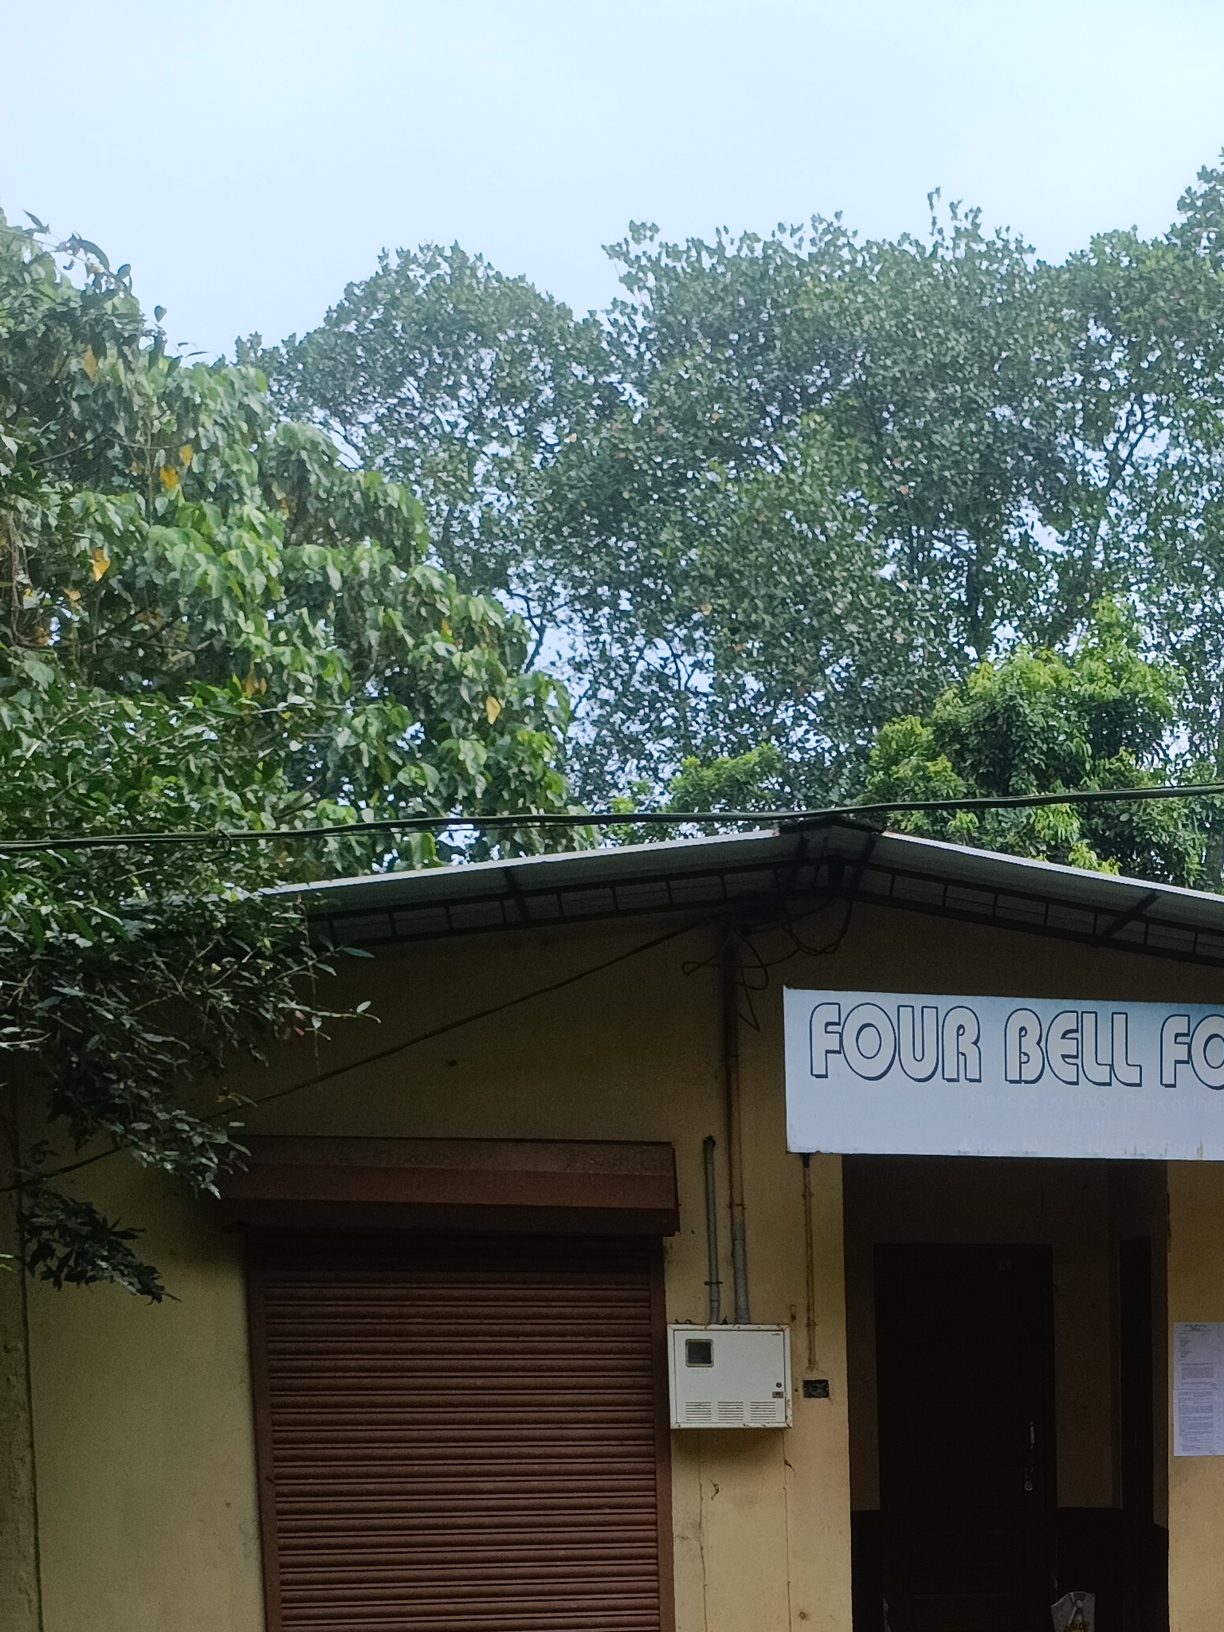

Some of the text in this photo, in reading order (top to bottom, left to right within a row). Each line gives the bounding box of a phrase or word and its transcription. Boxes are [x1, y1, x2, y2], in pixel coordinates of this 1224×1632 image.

[809, 1002, 983, 1083] FOUR
[1004, 1007, 1144, 1087] BELL
[1069, 1092, 1119, 1110] Union
[1123, 1093, 1167, 1112] Bank
[1172, 1094, 1189, 1113] of
